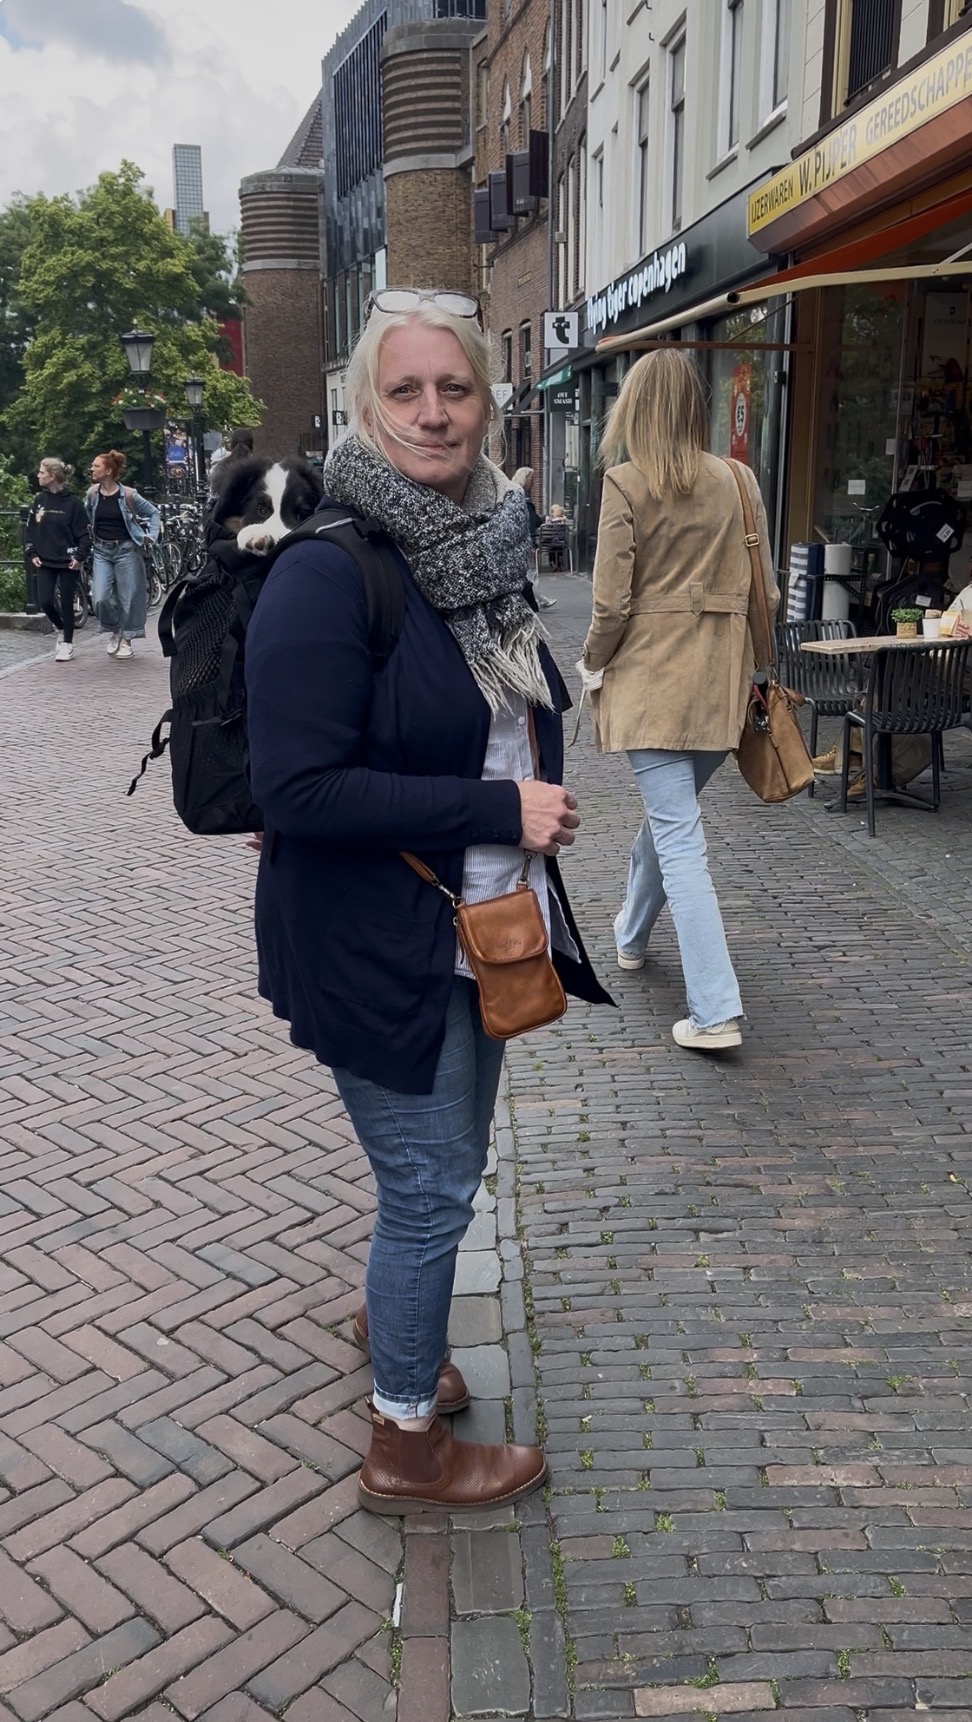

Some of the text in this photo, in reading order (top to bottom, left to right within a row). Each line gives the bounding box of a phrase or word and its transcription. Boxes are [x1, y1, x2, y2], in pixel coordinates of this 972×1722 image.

[751, 175, 794, 224] IJZERWAREN
[607, 280, 627, 324] tiger
[628, 242, 687, 308] copenhagen
